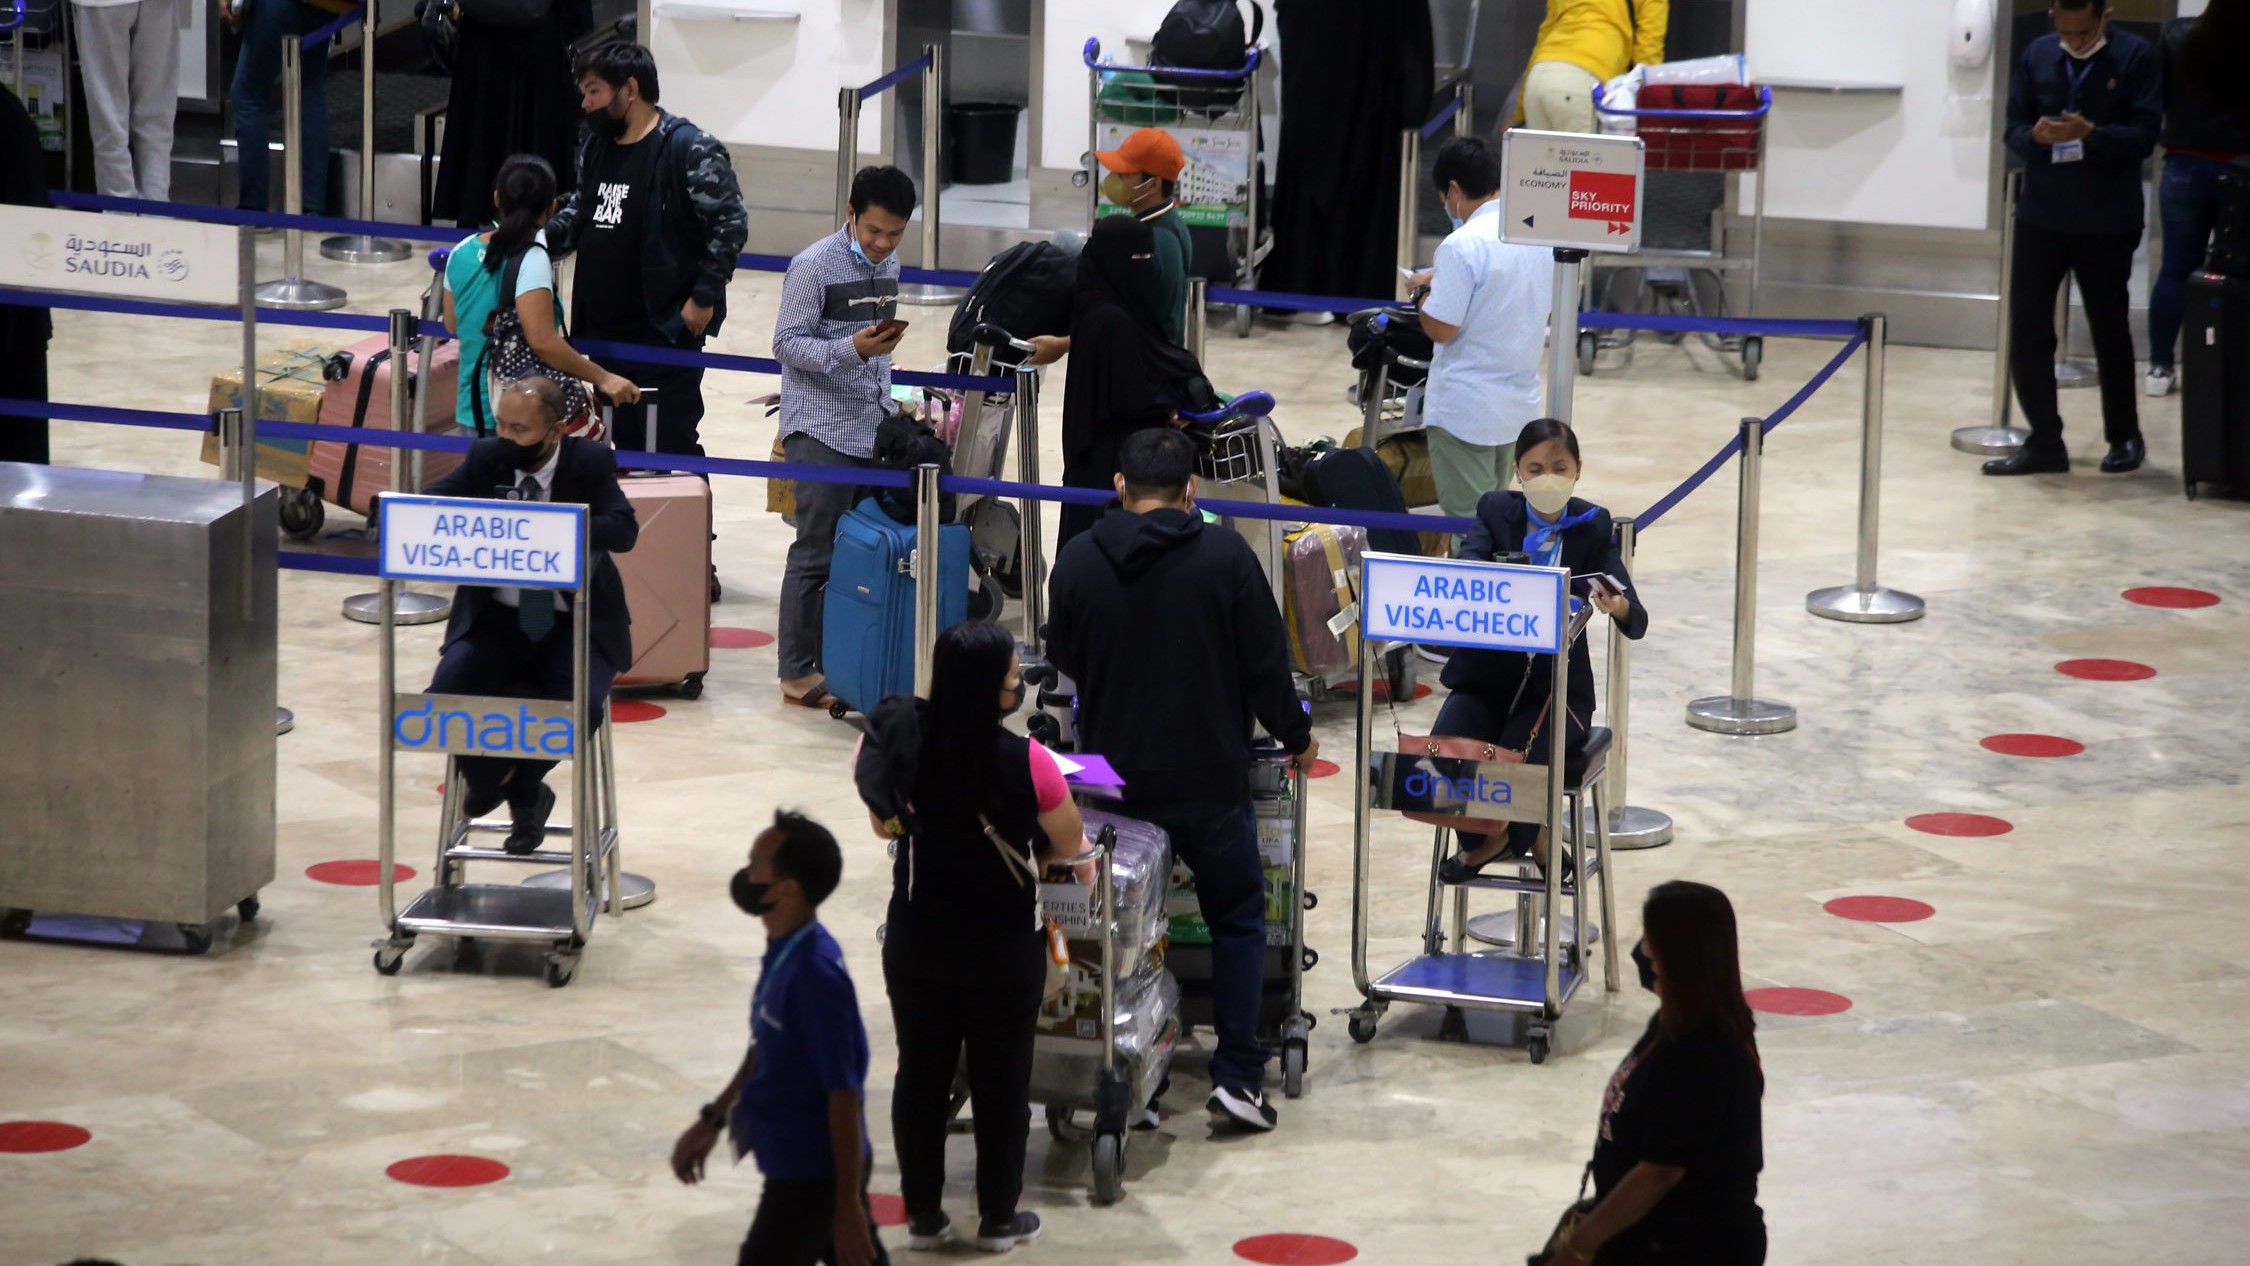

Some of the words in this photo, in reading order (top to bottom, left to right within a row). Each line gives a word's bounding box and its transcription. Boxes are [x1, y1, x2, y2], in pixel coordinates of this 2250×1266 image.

[597, 182, 630, 200] RAISE
[1519, 178, 1567, 190] ECONOMY
[1571, 190, 1597, 201] SKY
[603, 196, 622, 208] THE
[1570, 201, 1630, 214] PRIORITY
[592, 204, 623, 224] BAR
[65, 233, 151, 257] السعودية
[65, 256, 150, 279] SAUDIA
[433, 514, 531, 541] ARABIC
[402, 543, 560, 573] VISA-CHECK
[1413, 575, 1512, 604] ARABIC
[1384, 603, 1539, 638] VISA-CHECK
[394, 699, 574, 755] dnata
[1405, 768, 1512, 804] dnata
